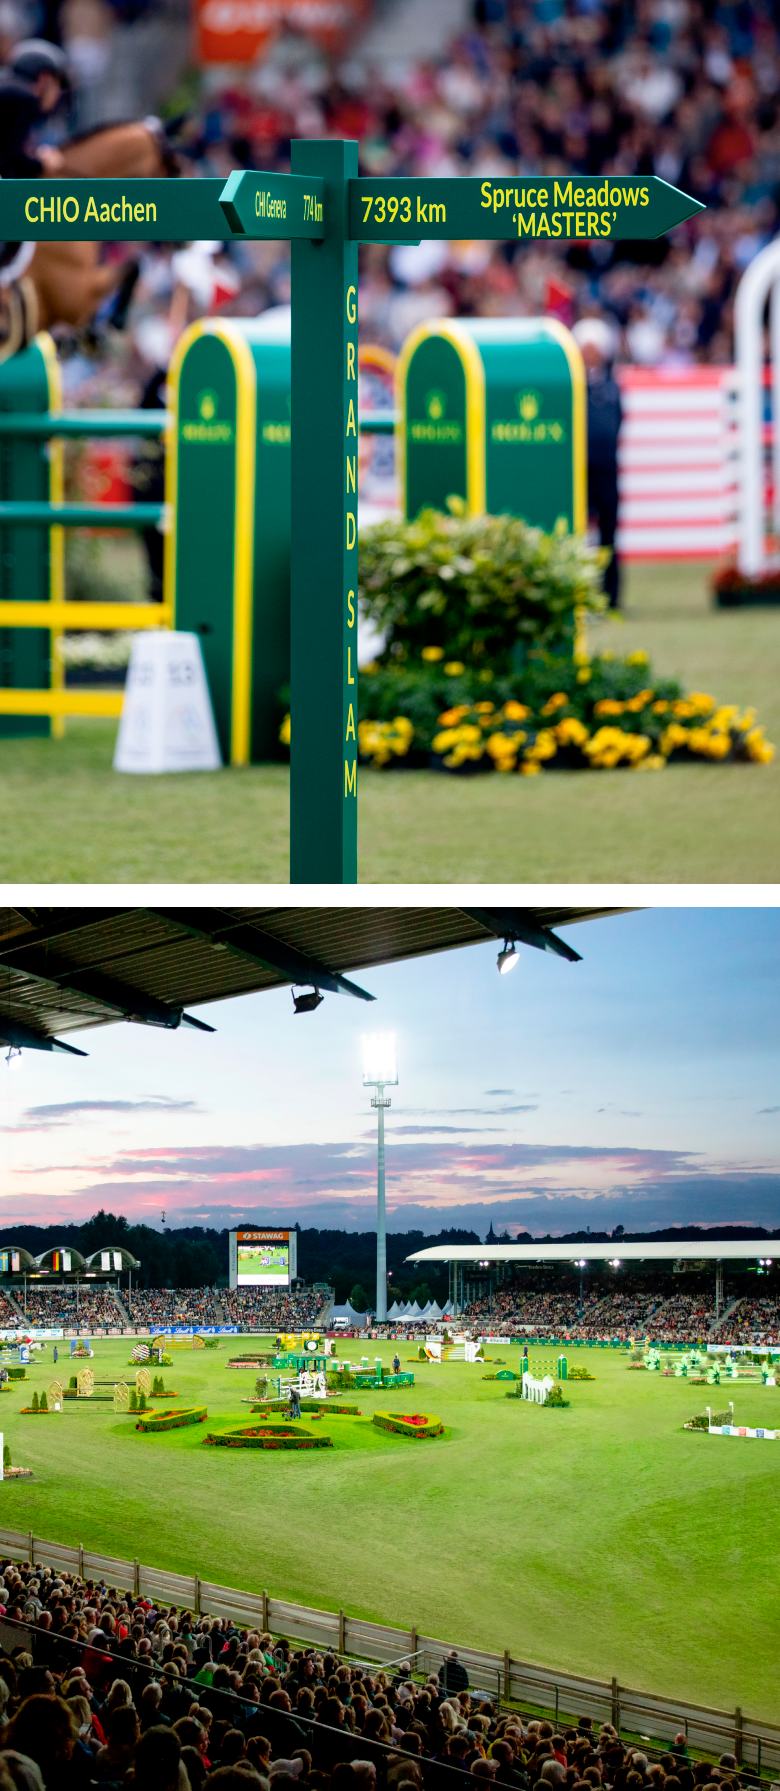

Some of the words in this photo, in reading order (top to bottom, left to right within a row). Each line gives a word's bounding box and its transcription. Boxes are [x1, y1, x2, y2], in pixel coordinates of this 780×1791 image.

[24, 196, 80, 223] CHIO
[83, 195, 157, 223] Aachen
[255, 190, 266, 217] CHI
[266, 191, 287, 219] Geneva
[303, 194, 314, 221] 774
[314, 195, 323, 222] km
[361, 196, 412, 223] 7393
[416, 195, 446, 223] km
[480, 181, 549, 213] Spruce
[553, 179, 650, 207] Meadows
[345, 285, 357, 551] GRAND
[344, 589, 357, 798] SLAM
[252, 1232, 284, 1240] STAWAG
